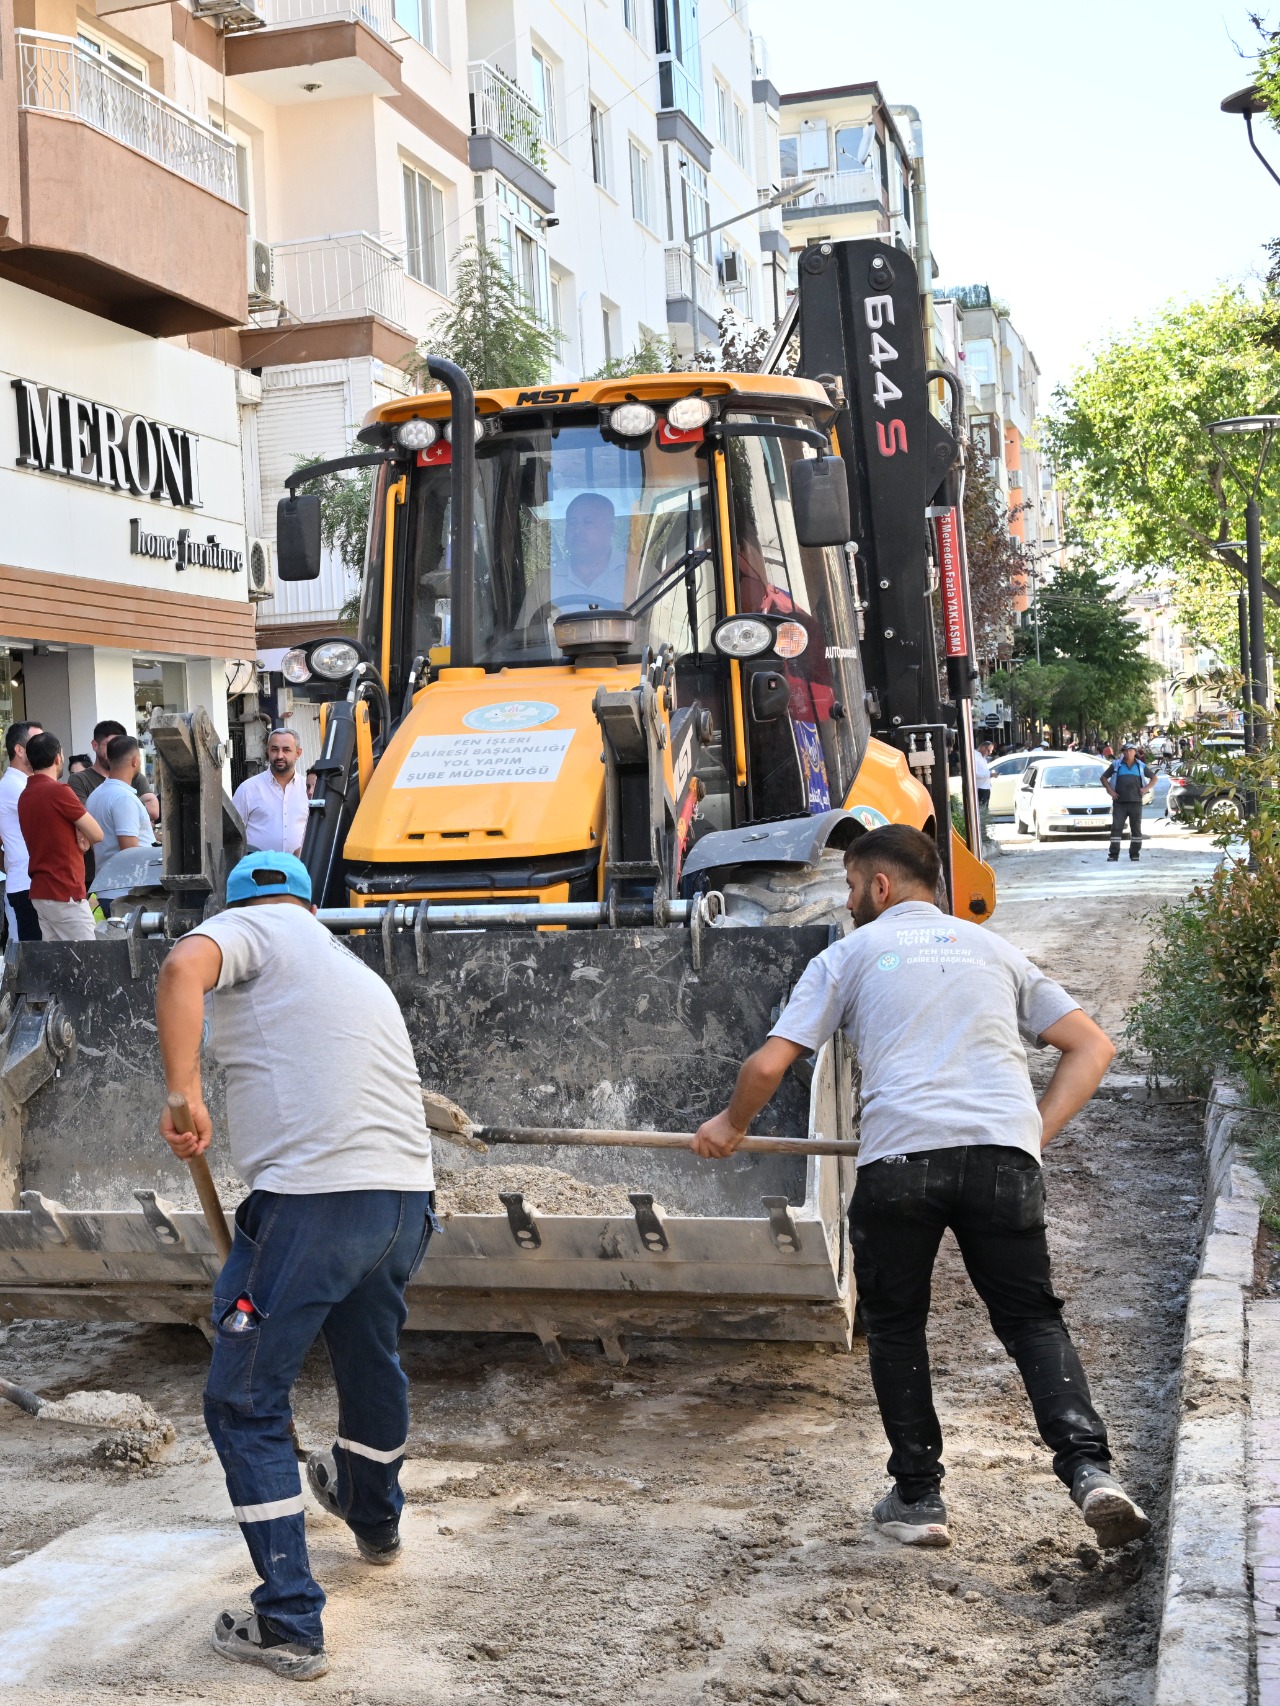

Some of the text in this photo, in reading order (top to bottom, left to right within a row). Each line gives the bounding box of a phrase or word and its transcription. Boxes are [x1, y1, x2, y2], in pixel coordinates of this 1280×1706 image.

[864, 294, 908, 457] 644 S
[516, 388, 579, 406] MST
[11, 379, 204, 508] MERONI
[130, 518, 178, 561] home
[176, 528, 244, 572] furniture
[942, 524, 953, 571] Metreden
[945, 572, 956, 597] Fazla
[947, 598, 962, 653] YAKLAŞMA
[410, 743, 566, 759] DAİRESİ BAŞKANLIĞI
[453, 735, 532, 747] FEN İŞLERİ
[443, 756, 522, 768] YOL YAPIM
[406, 765, 550, 783] ŞUBE MÜDÜRLÜĞÜ
[906, 956, 939, 964] DAİRESİ
